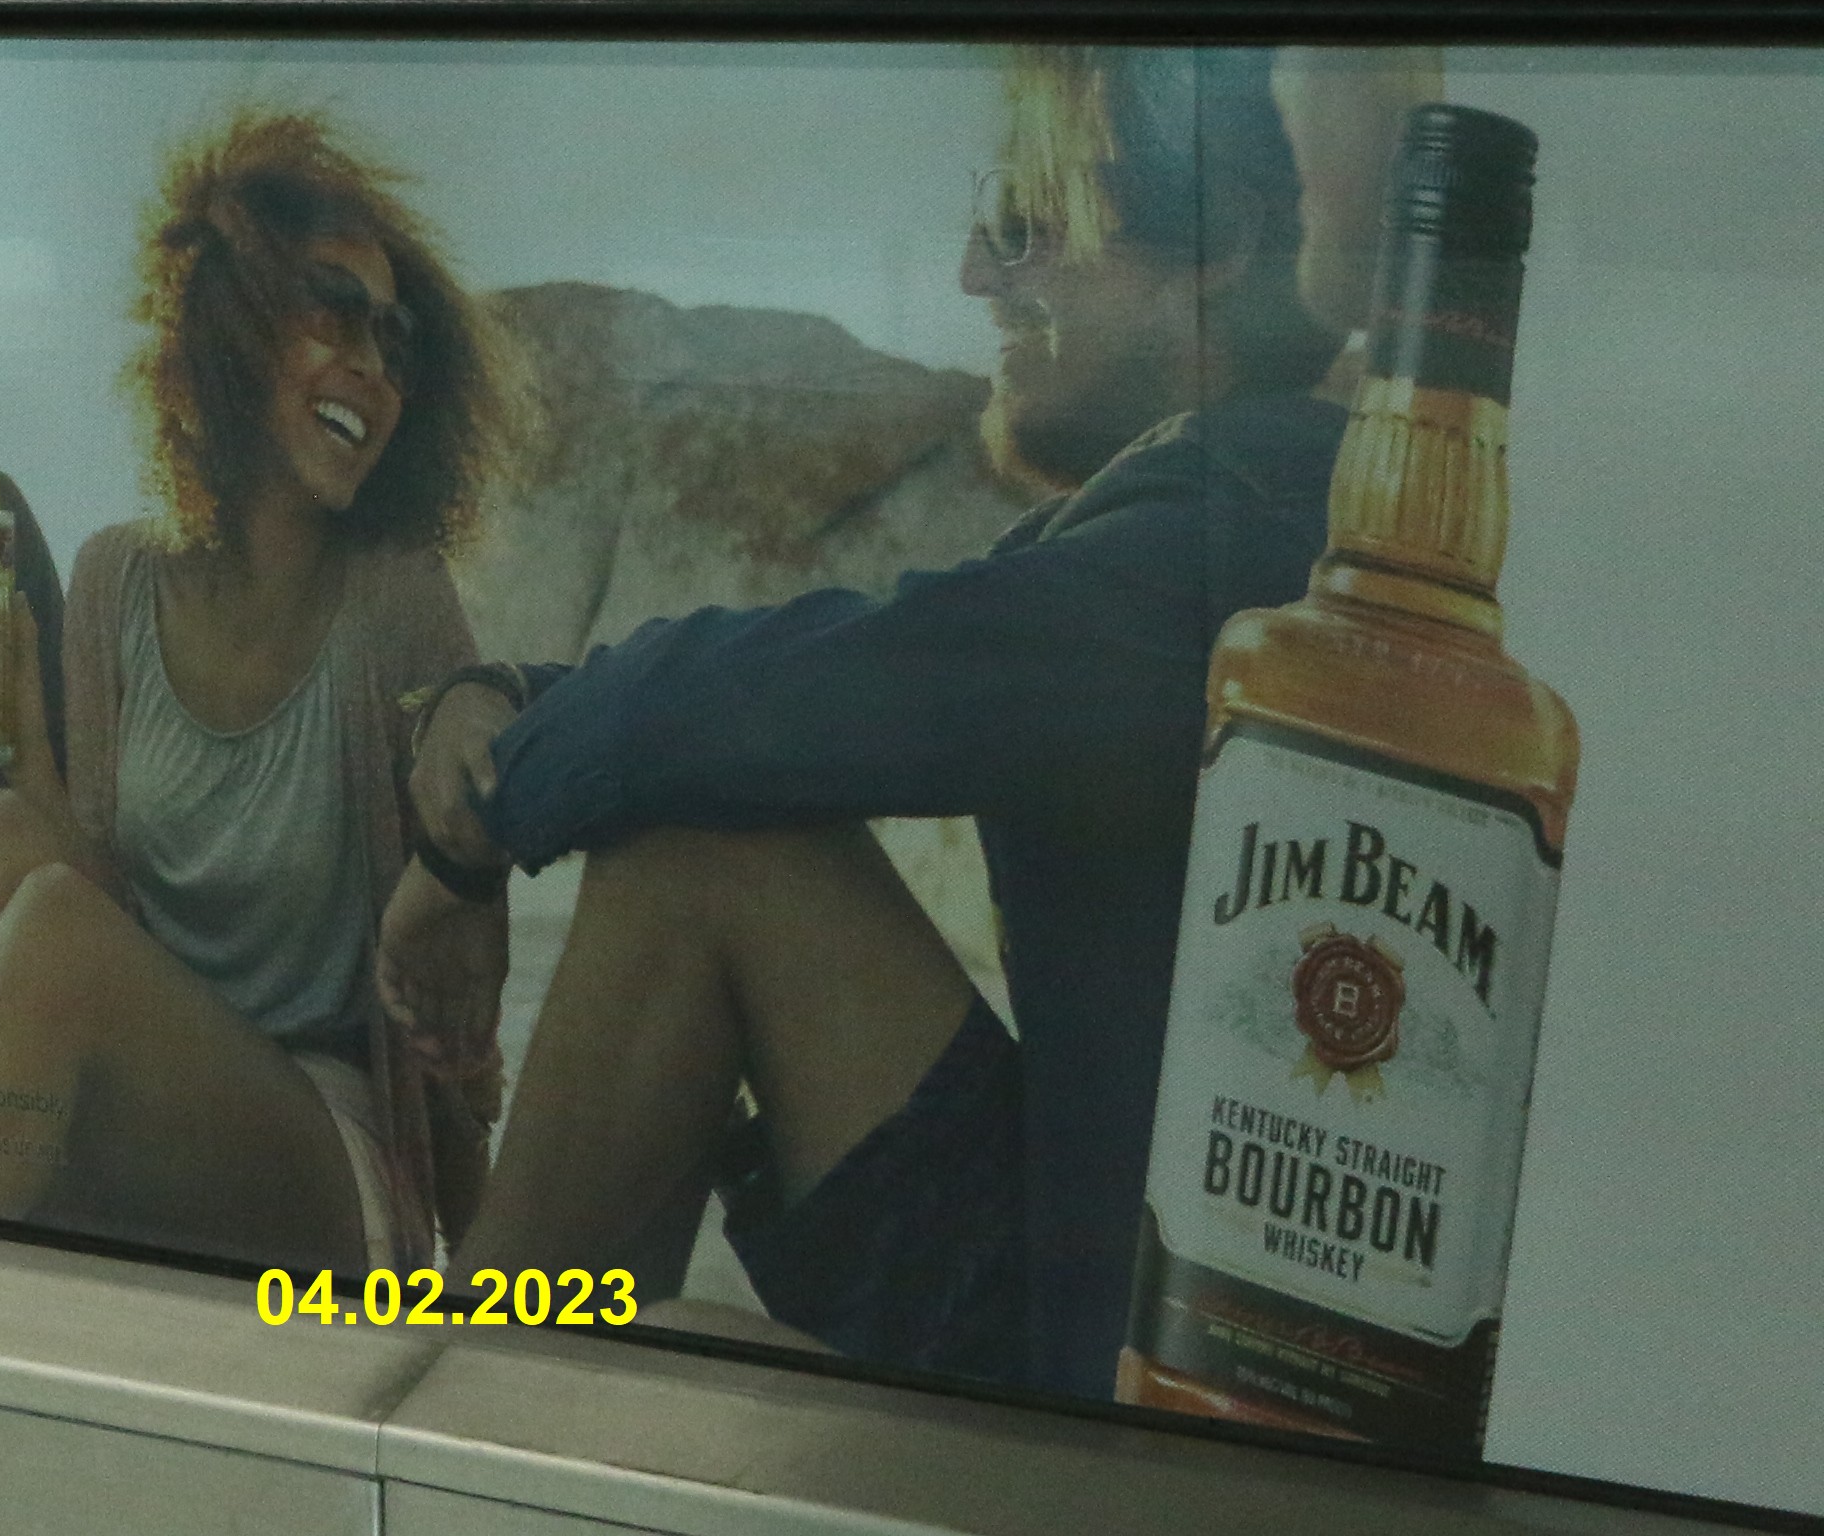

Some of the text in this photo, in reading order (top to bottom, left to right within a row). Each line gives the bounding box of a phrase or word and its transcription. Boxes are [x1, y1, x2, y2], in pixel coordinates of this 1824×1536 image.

[1213, 821, 1329, 926] JIM
[1338, 819, 1501, 1009] BEAM
[1202, 1130, 1444, 1273] BOURBON
[1211, 1094, 1447, 1196] KENTUCKY STRAIGHT
[1262, 1222, 1365, 1282] WHISKEY
